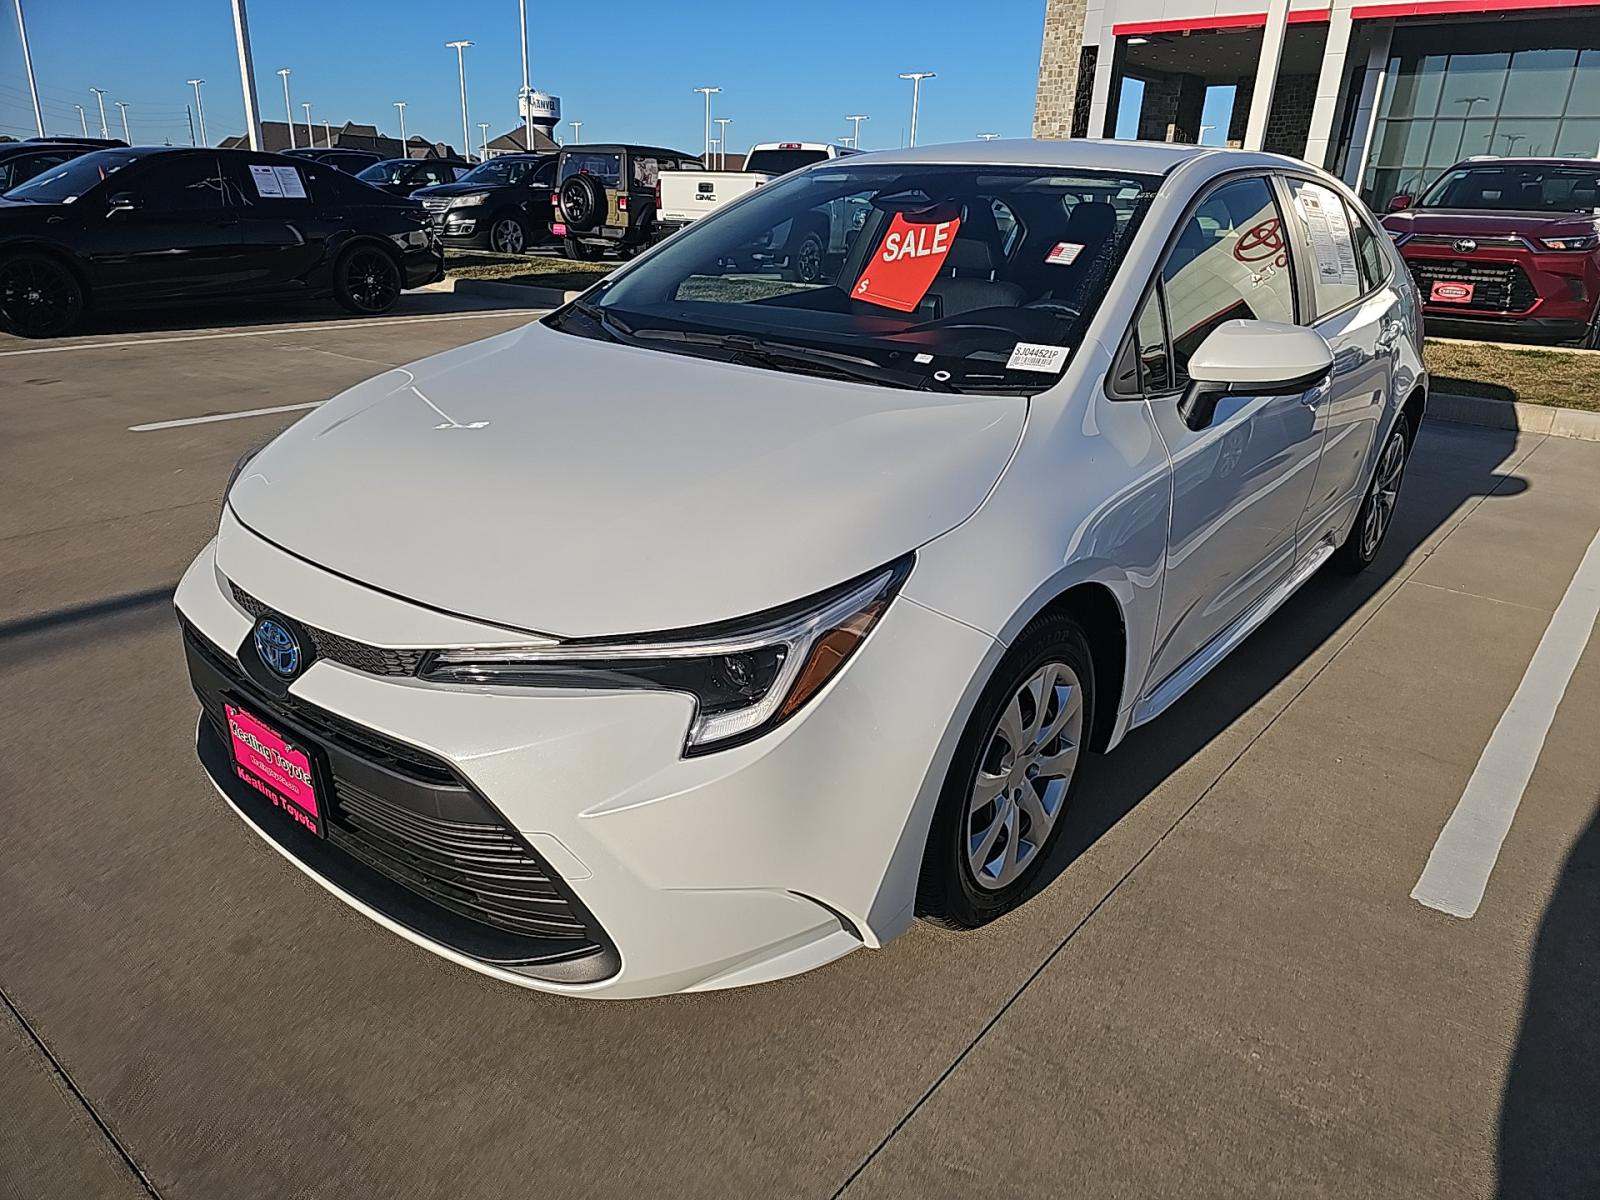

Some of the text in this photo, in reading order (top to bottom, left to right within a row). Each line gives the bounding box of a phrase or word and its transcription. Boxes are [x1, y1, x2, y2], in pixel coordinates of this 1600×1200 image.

[882, 222, 950, 262] SALE
[857, 279, 870, 294] $
[228, 718, 278, 763] Keating
[271, 748, 313, 787] Toyota
[236, 765, 279, 806] Keating
[280, 795, 317, 834] Toyota
